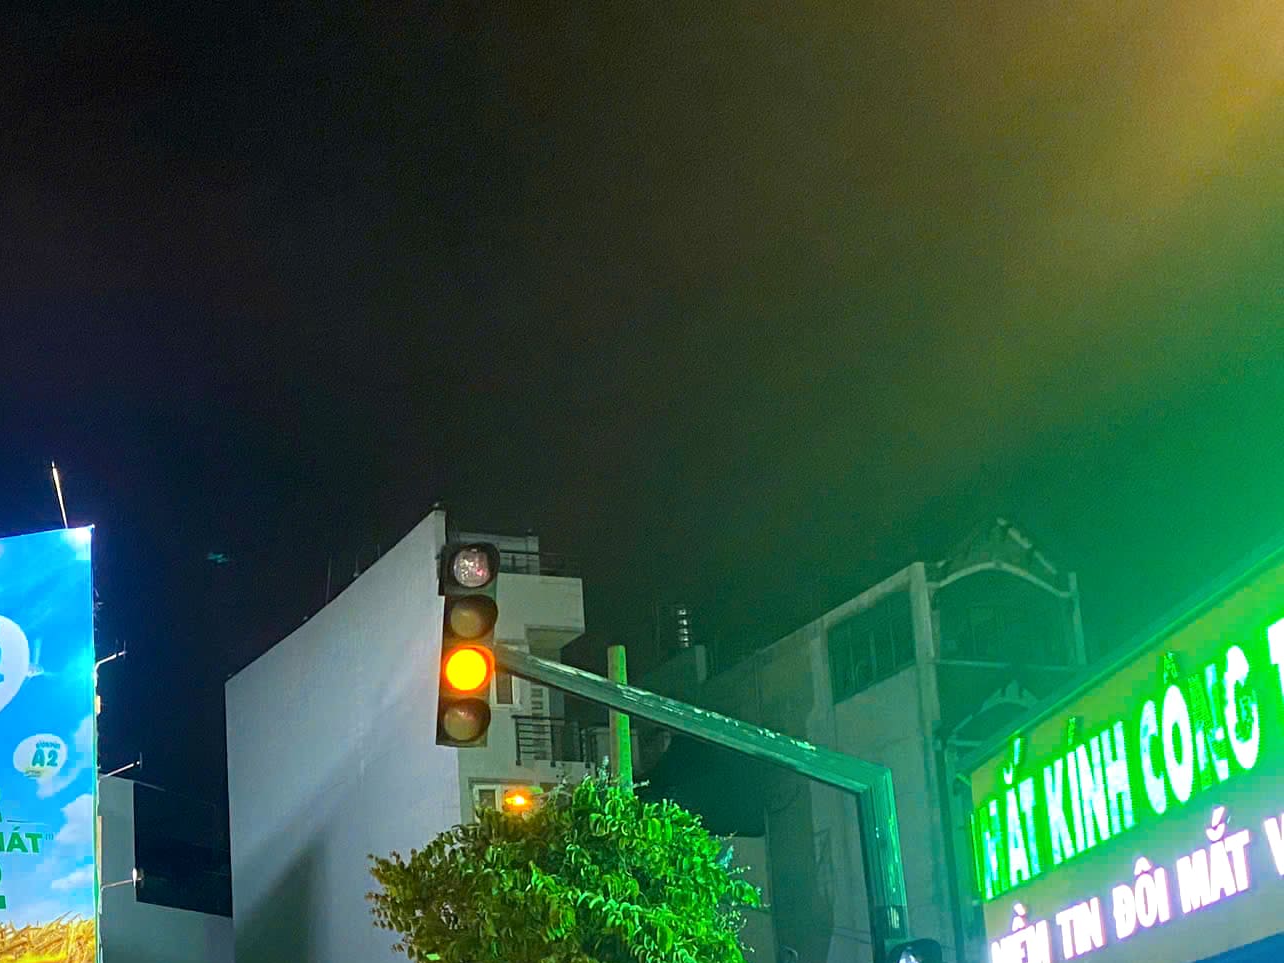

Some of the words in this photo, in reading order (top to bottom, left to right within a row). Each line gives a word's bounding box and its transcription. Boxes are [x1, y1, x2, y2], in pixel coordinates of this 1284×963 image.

[1044, 716, 1136, 866] KÍNH
[1140, 645, 1260, 815] CÔNG
[1055, 896, 1106, 960] TIN
[1112, 856, 1171, 940] ĐÔI
[1177, 806, 1251, 914] MẮT
